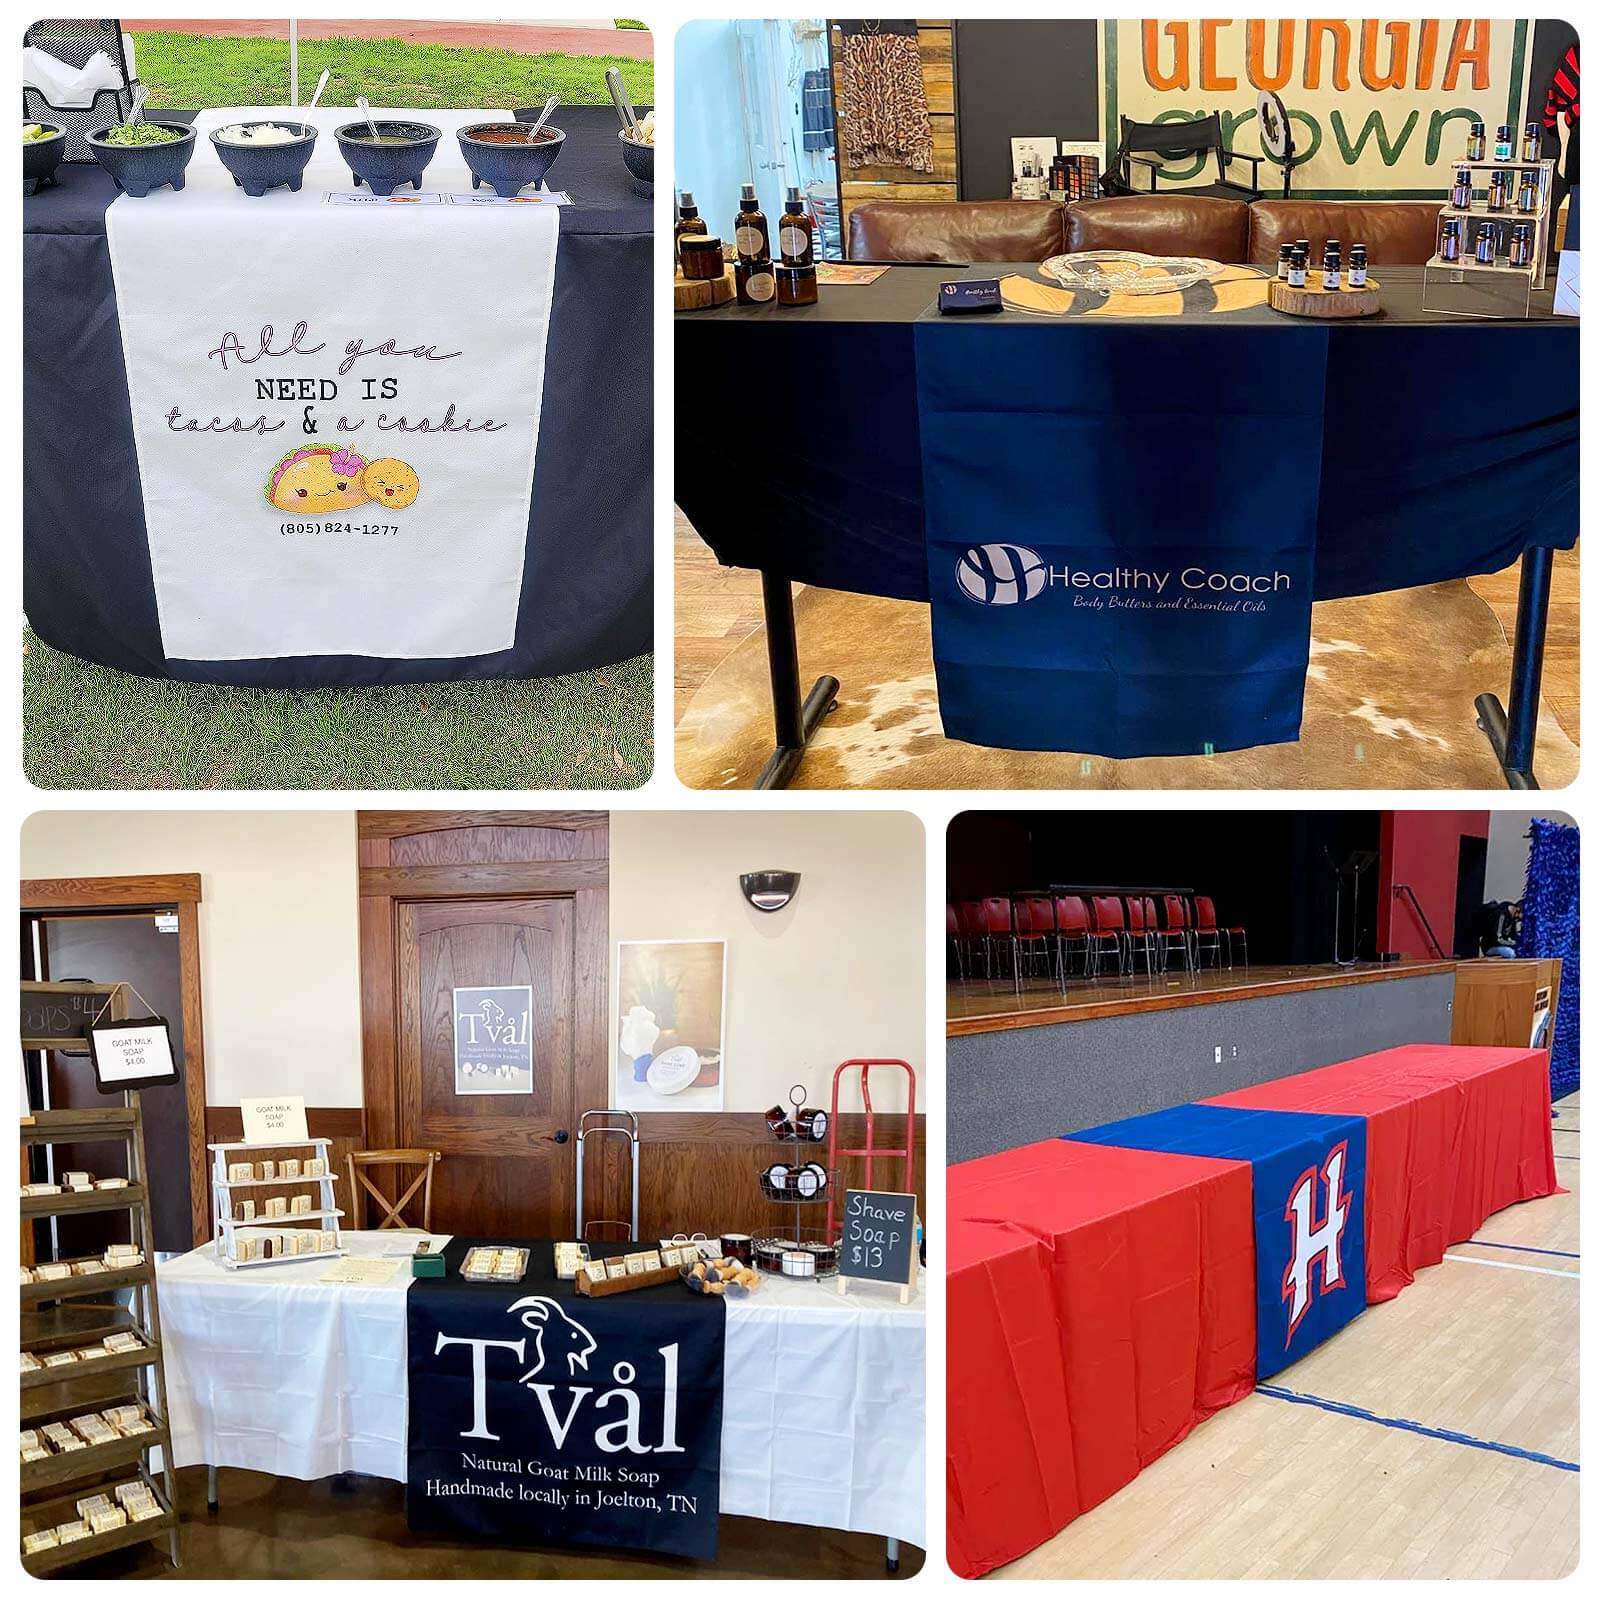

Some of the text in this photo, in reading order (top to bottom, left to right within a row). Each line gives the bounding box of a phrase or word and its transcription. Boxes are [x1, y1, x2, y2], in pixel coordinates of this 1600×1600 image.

[1142, 19, 1490, 91] GEORGIA
[208, 321, 463, 376] All you
[255, 377, 399, 401] NEED IS
[165, 403, 508, 435] tacos & a cookie
[1049, 565, 1291, 594] Healthy Coach
[1073, 594, 1267, 613] Body Butters and Essential Oils
[111, 1037, 153, 1047] GOAT MILK
[459, 1009, 528, 1045] Tvål
[122, 1048, 144, 1056] SOAP
[847, 1195, 906, 1222] Shave
[850, 1219, 901, 1251] Soap
[1283, 1141, 1351, 1347] H
[851, 1245, 883, 1268] $13
[434, 1331, 685, 1454] Tvål
[461, 1452, 660, 1488] Natural Goat Milk Soap
[426, 1478, 698, 1514] Handmade locally in Joelton, TN
